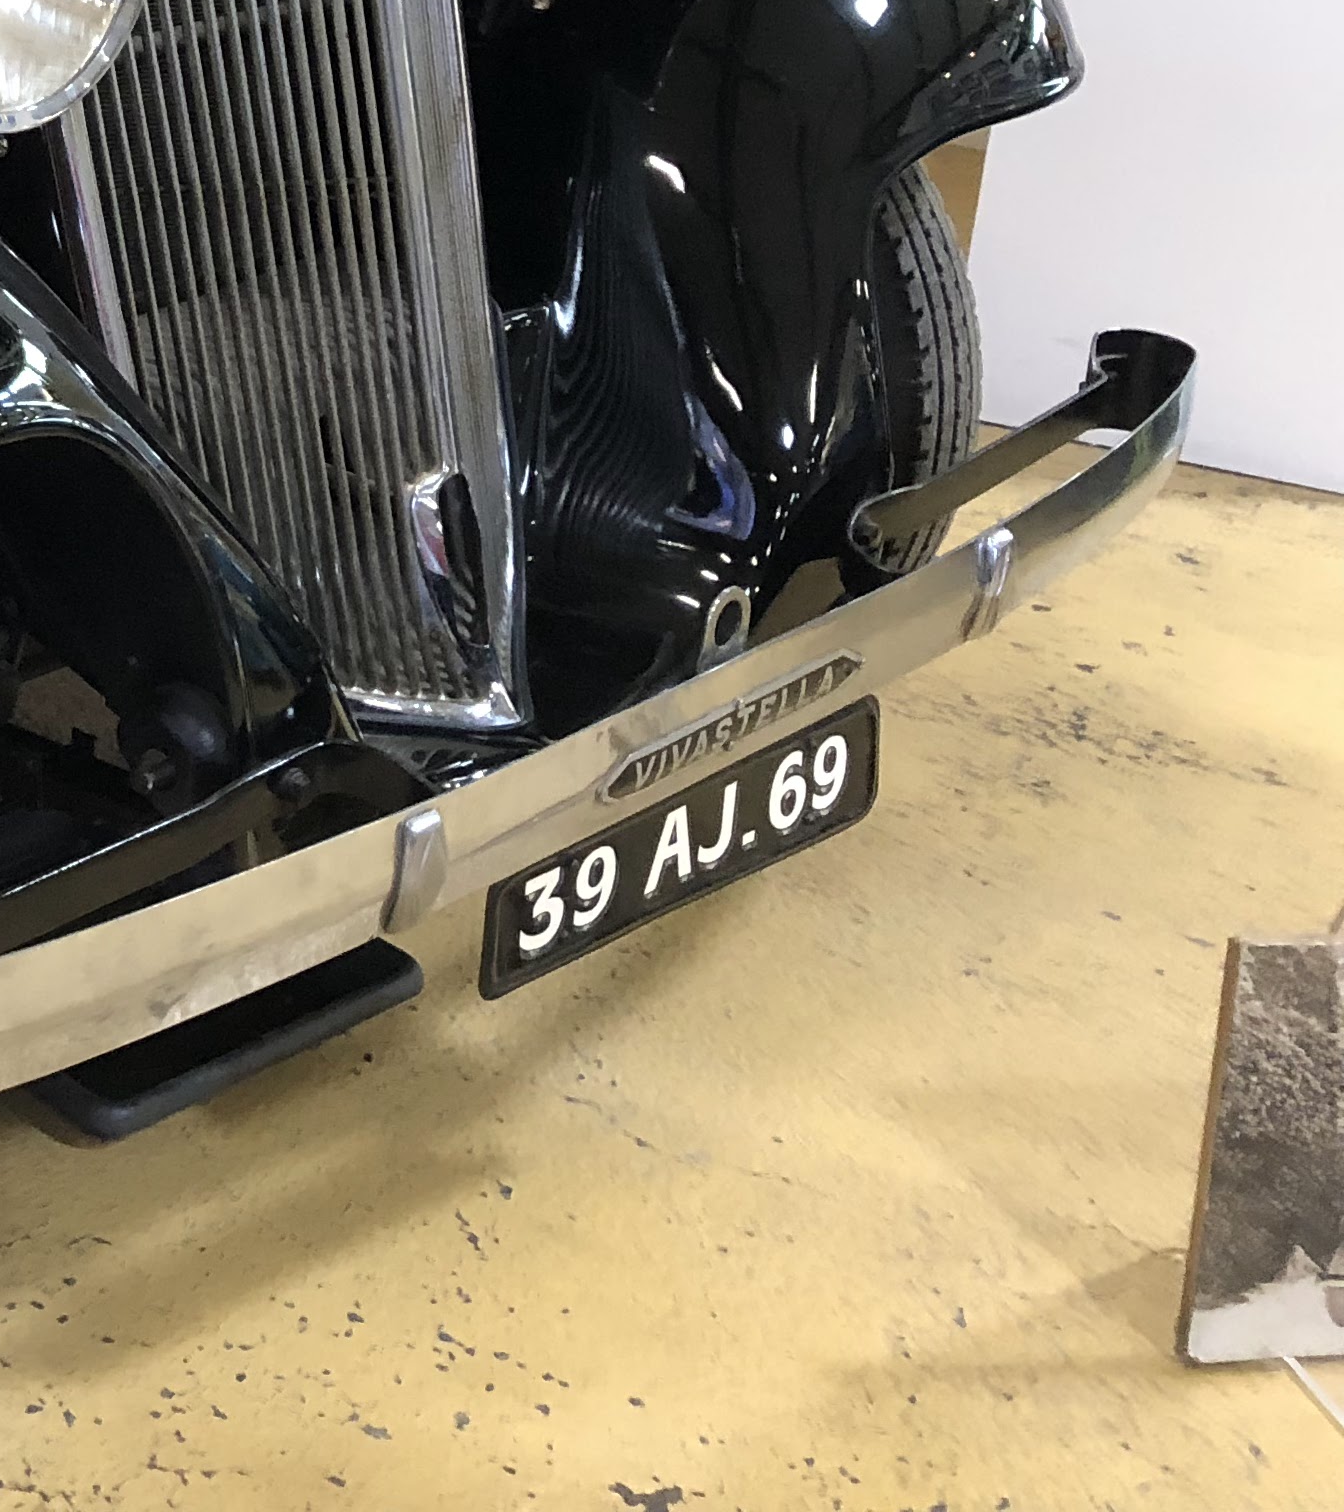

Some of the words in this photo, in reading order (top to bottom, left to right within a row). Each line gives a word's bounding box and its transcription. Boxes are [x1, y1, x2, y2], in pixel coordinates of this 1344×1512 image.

[635, 664, 835, 790] VIVASTELLA
[518, 844, 618, 952] 39
[768, 734, 849, 832] 69
